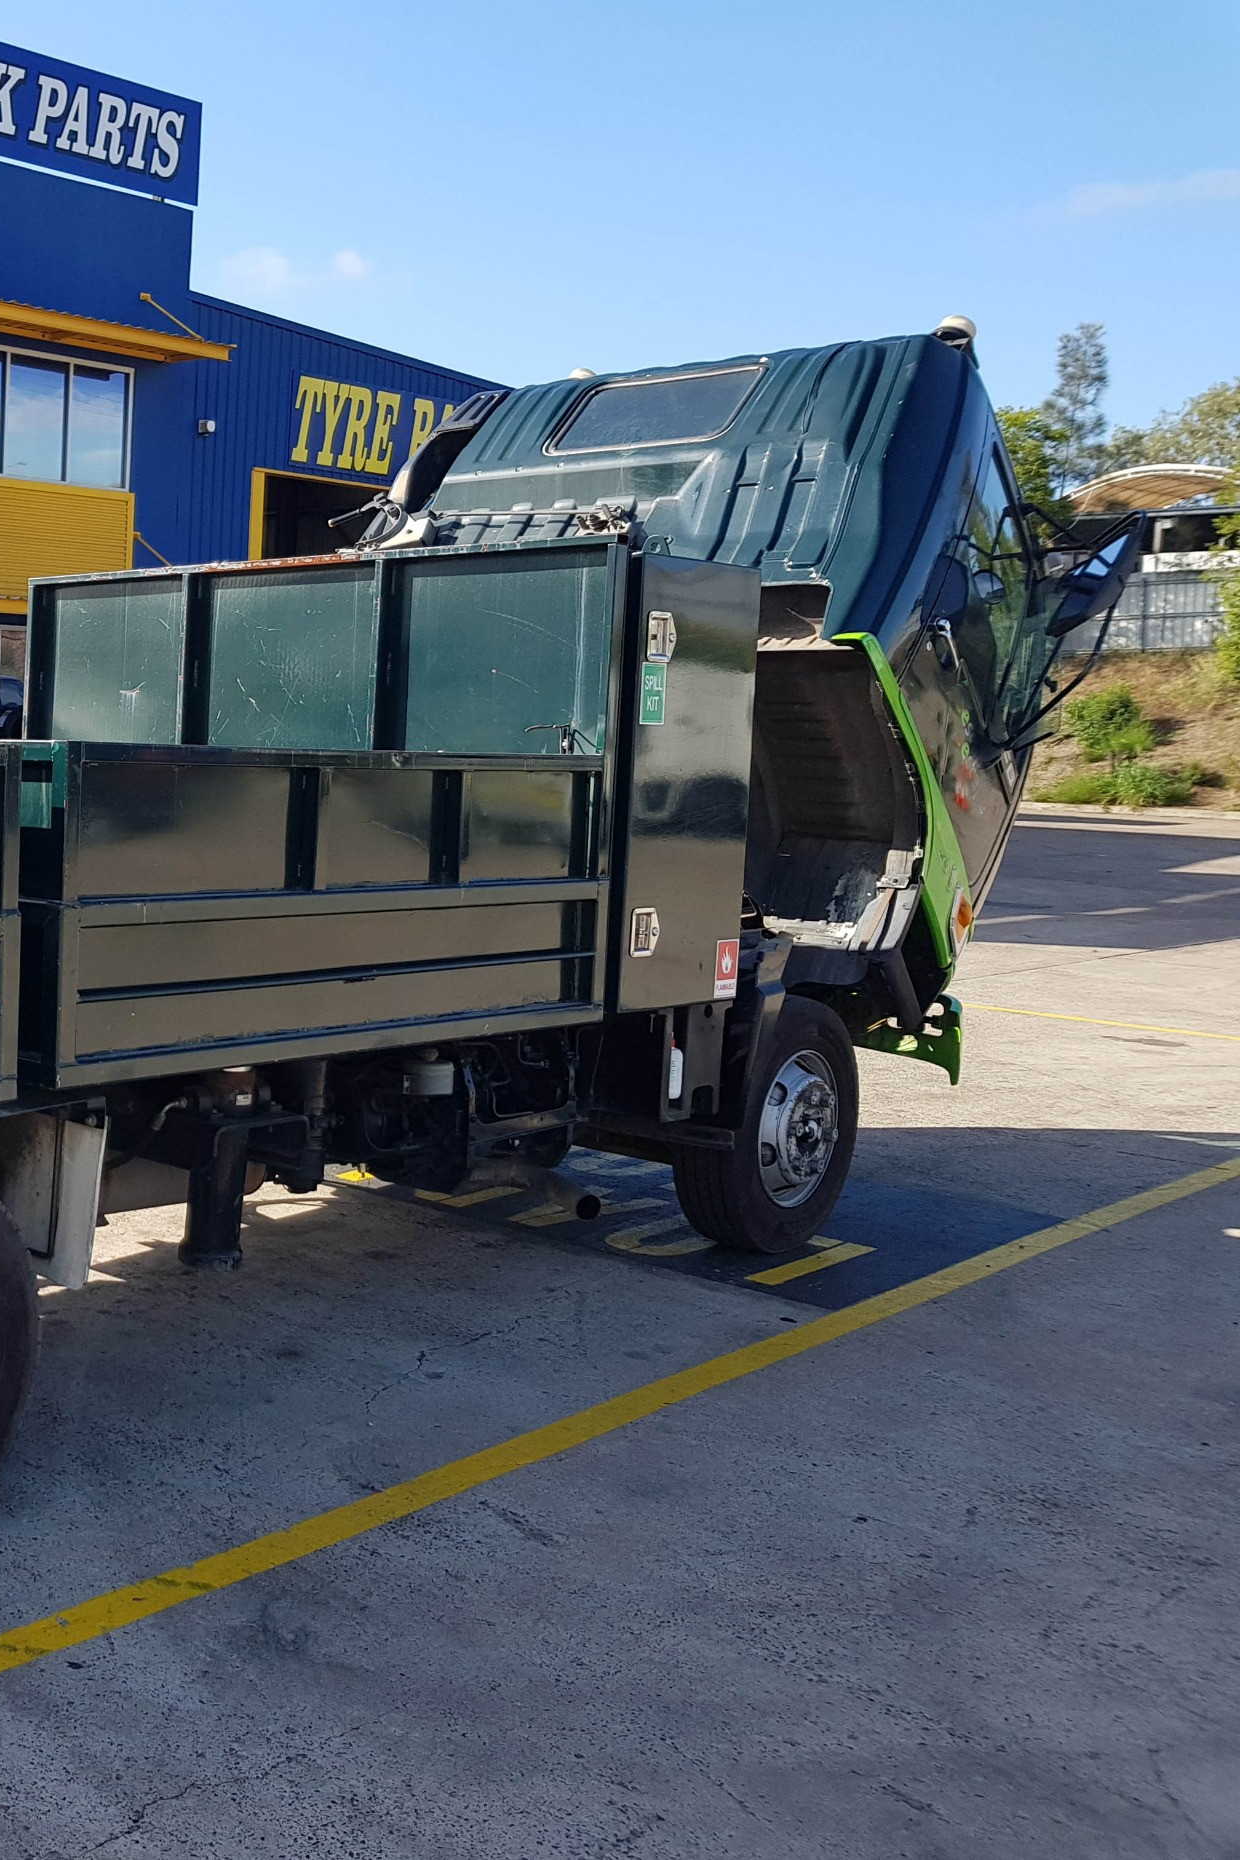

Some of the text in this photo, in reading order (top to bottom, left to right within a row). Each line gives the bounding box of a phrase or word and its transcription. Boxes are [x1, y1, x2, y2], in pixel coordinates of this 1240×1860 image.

[27, 75, 185, 178] PARTS
[291, 375, 401, 475] TYRE
[644, 675, 663, 691] SPILL
[646, 695, 660, 711] KIT
